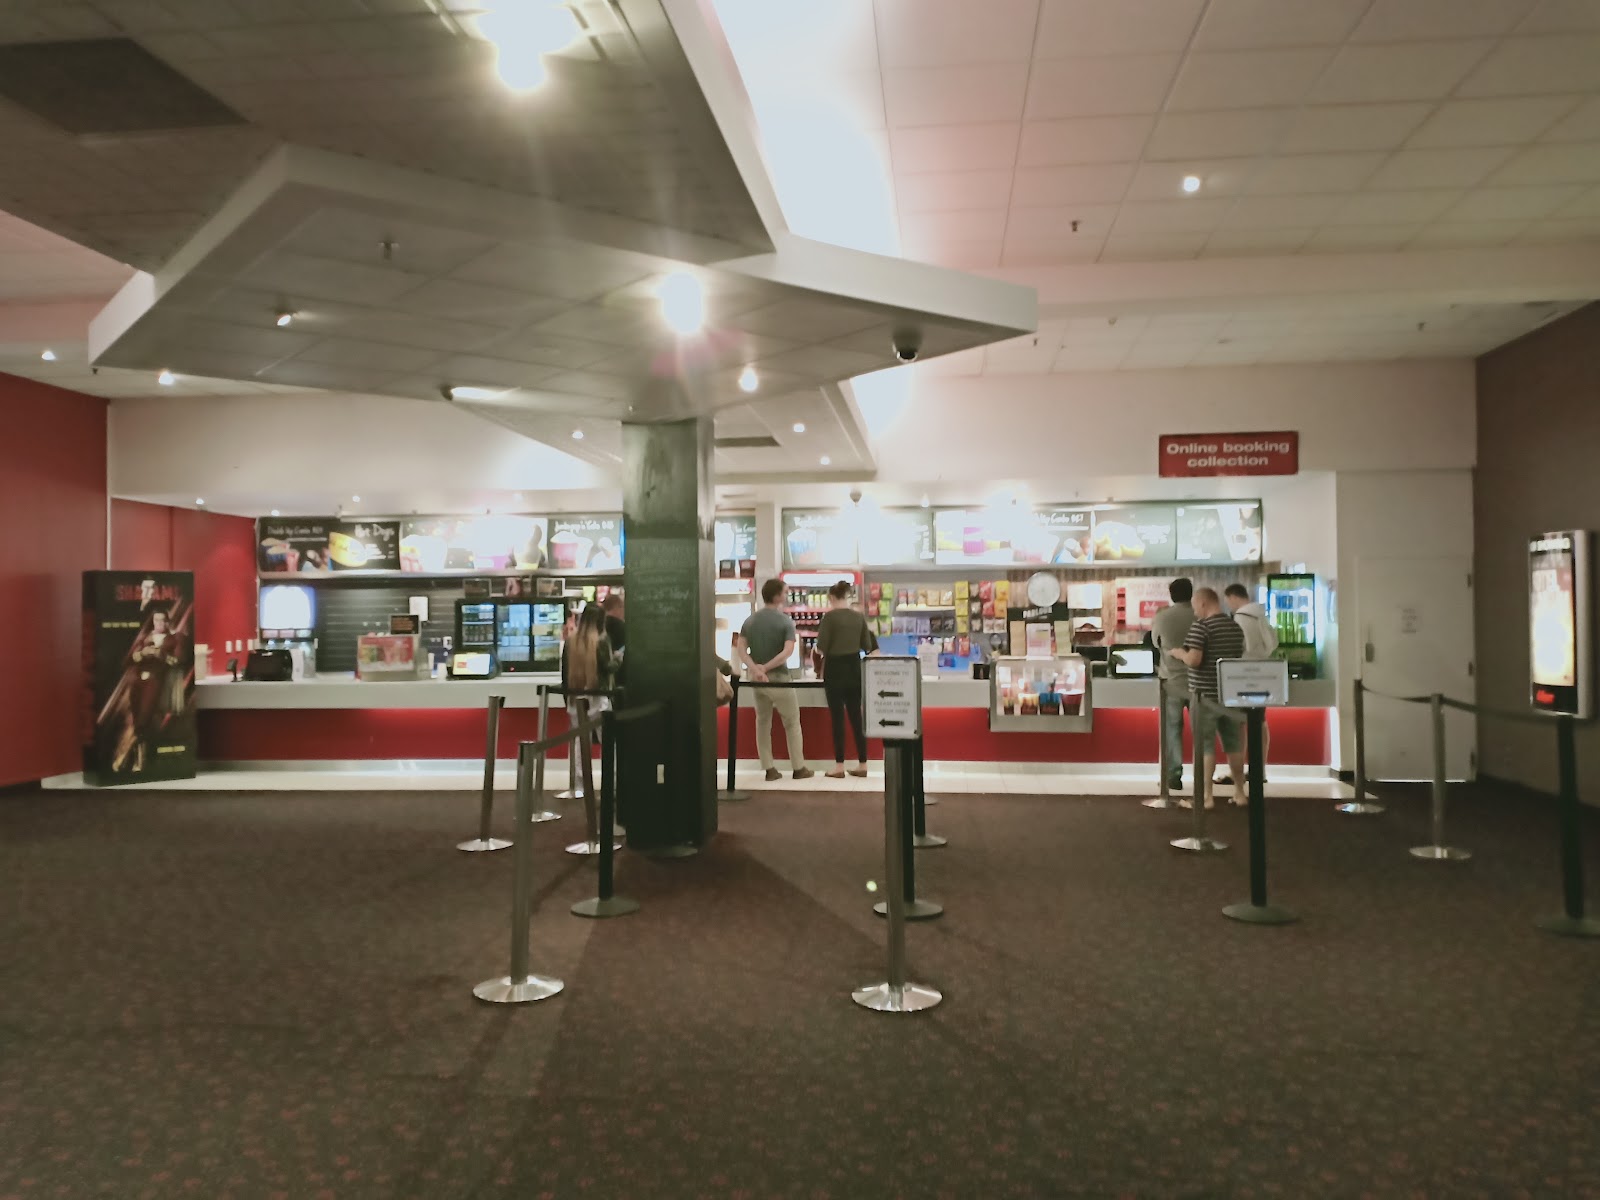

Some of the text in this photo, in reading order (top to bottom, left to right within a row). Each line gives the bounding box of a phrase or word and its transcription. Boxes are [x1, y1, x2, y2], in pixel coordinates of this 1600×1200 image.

[1166, 440, 1290, 455] Online booking
[1187, 454, 1269, 468] collection
[372, 523, 396, 542] Dogs
